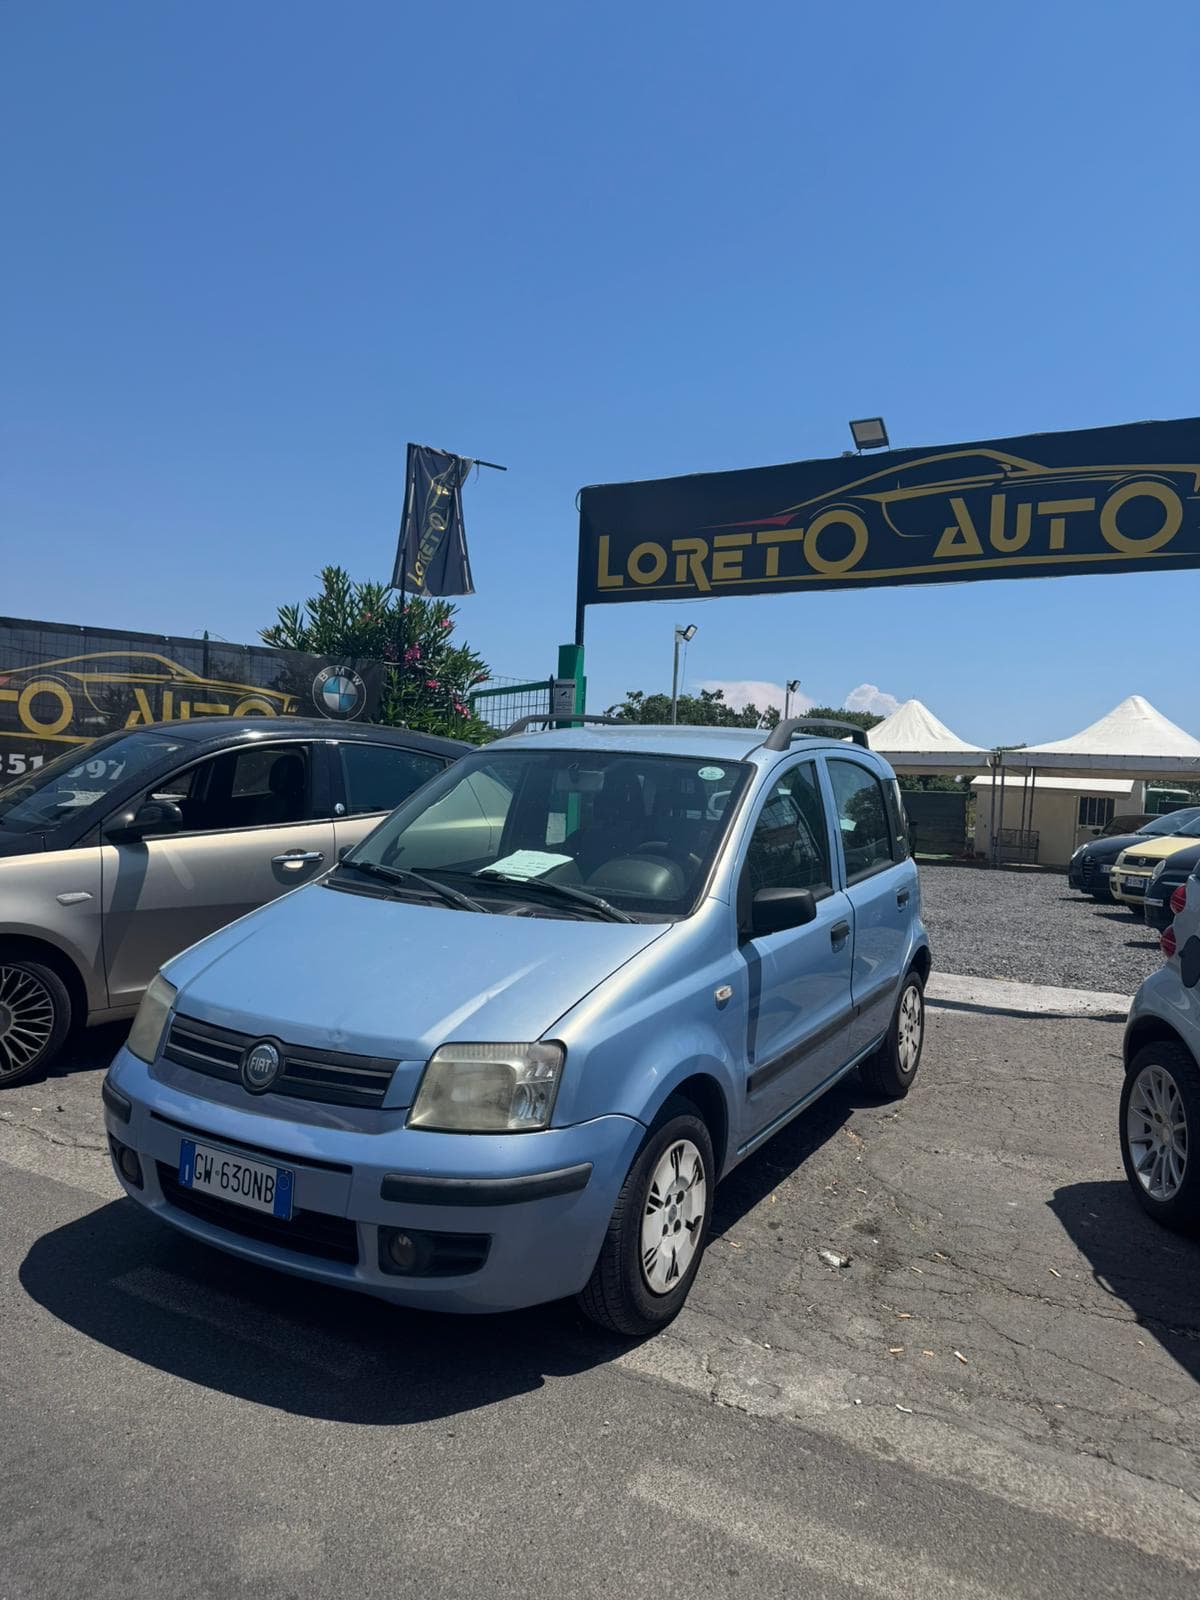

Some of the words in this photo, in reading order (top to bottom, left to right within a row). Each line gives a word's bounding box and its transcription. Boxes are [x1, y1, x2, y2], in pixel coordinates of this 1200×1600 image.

[599, 510, 868, 591] LORETO
[933, 481, 1183, 554] AUTO
[319, 667, 363, 685] BMW
[0, 753, 44, 775] 51
[250, 1056, 272, 1073] FIAT
